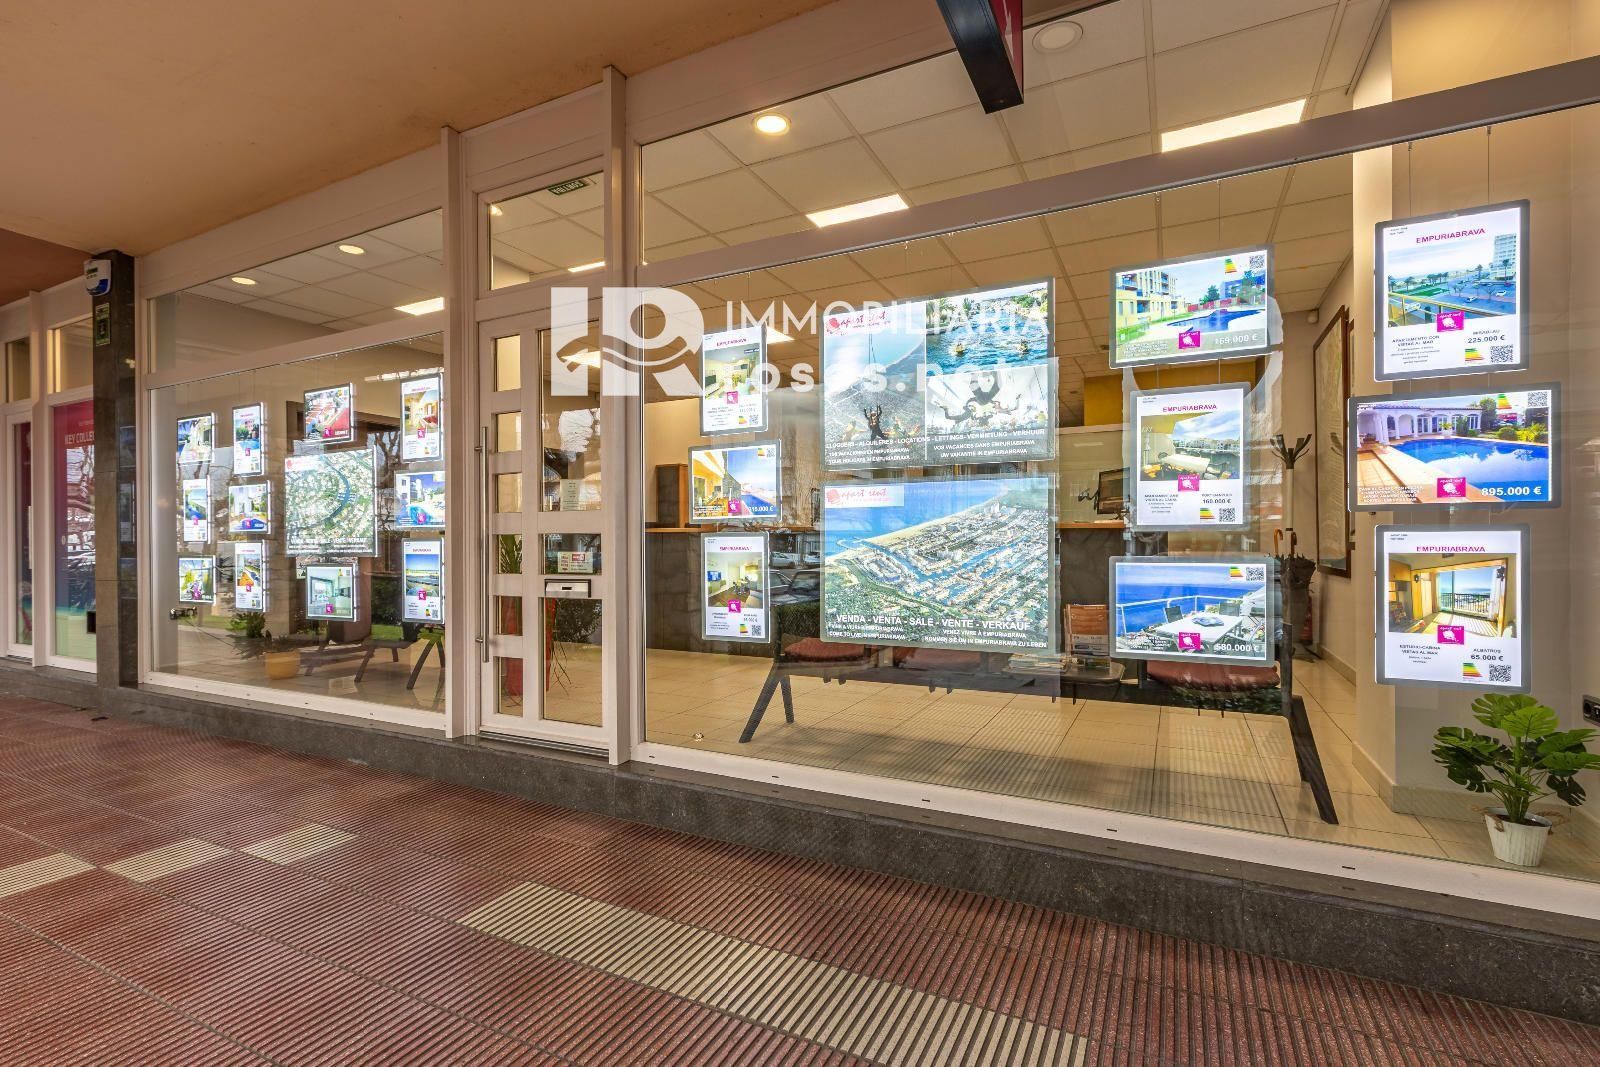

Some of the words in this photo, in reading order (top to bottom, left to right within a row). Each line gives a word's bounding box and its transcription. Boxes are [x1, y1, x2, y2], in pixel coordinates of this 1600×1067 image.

[1416, 228, 1486, 244] EMPURIABRAVA
[1467, 335, 1498, 344] 225.000
[1162, 404, 1218, 412] EMPURIABRAVA
[1481, 487, 1529, 497] 895.000
[1533, 486, 1542, 496] €
[836, 614, 866, 623] VENDA
[873, 615, 902, 625] VENTA
[909, 617, 934, 627] SALE
[941, 618, 974, 628] VENTE
[982, 620, 1031, 631] VERKAUF
